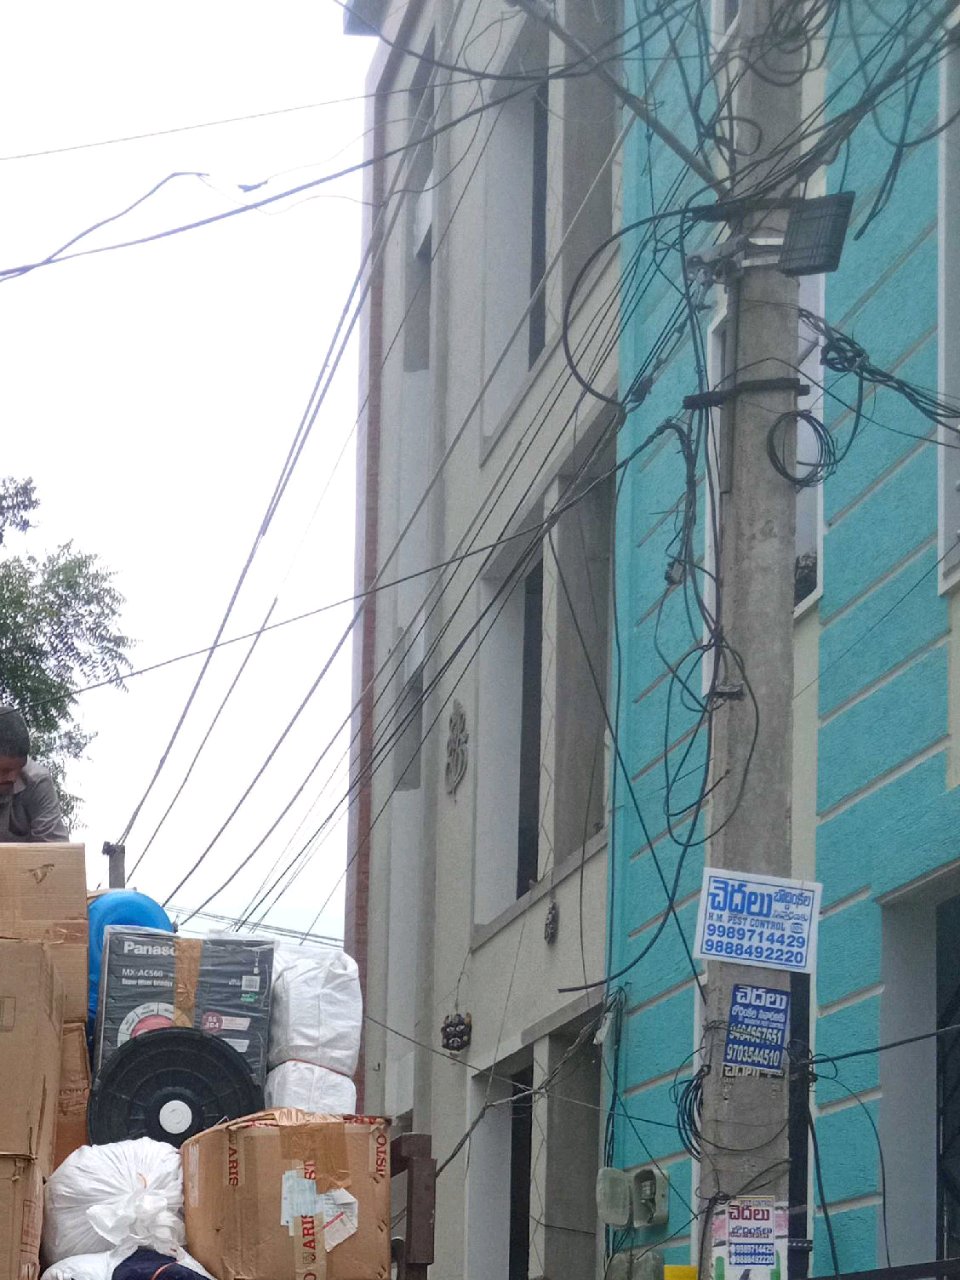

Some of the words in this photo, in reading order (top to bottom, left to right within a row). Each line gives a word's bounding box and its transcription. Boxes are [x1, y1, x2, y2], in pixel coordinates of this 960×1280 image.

[709, 879, 773, 918] చెదలు
[728, 915, 748, 926] PEST
[750, 918, 785, 931] CONTROL
[123, 941, 177, 956] Panas
[707, 923, 806, 949] 9989714429
[705, 939, 803, 964] 9888492220
[736, 985, 788, 1010] చెదలు
[726, 1044, 780, 1067] 9703544510
[228, 1146, 239, 1186] ARIS
